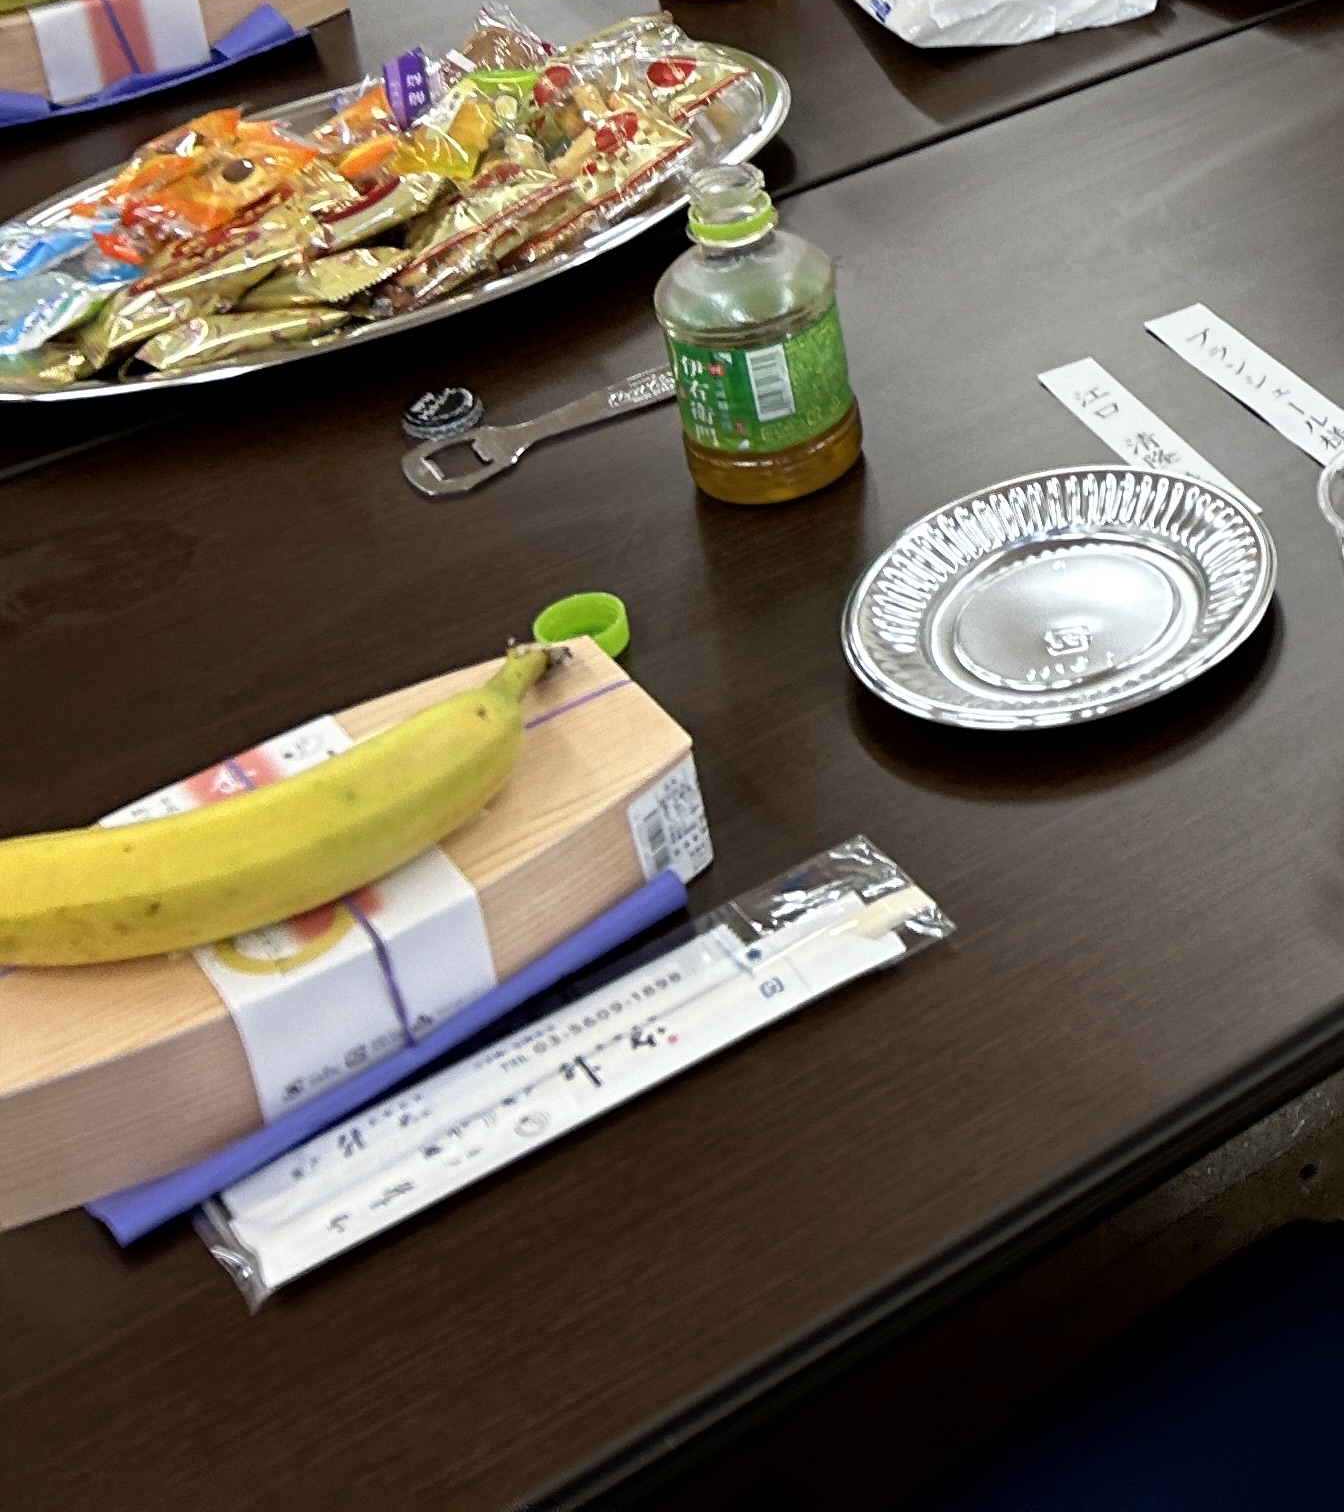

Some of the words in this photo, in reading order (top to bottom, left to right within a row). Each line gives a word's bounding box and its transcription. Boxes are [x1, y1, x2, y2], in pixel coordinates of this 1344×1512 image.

[679, 355, 720, 448] 伊右衛門
[1076, 386, 1119, 419] 江口
